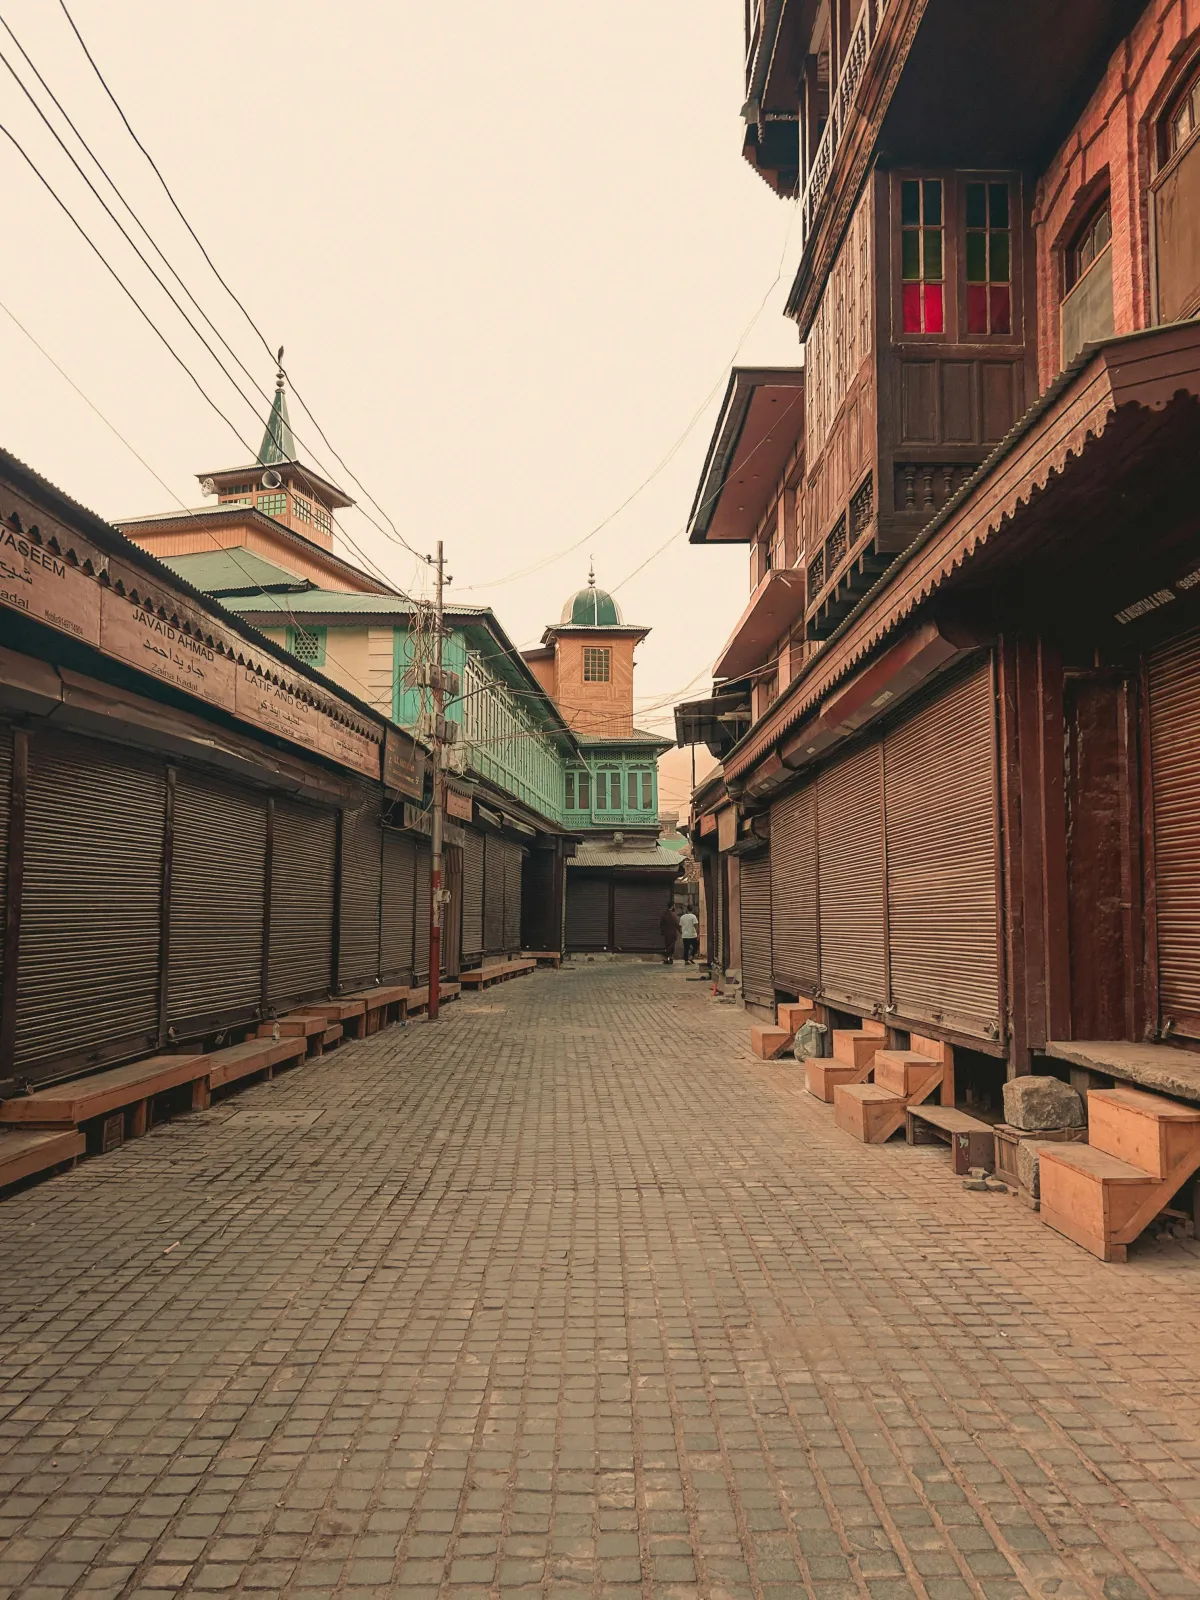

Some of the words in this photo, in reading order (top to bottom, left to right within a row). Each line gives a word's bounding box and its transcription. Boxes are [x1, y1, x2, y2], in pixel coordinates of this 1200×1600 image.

[1179, 568, 1200, 589] 9858
[0, 590, 29, 609] adal
[132, 609, 175, 640] JAVAID
[178, 634, 214, 662] AHMAD
[245, 671, 272, 693] LATIF
[274, 689, 293, 706] AND
